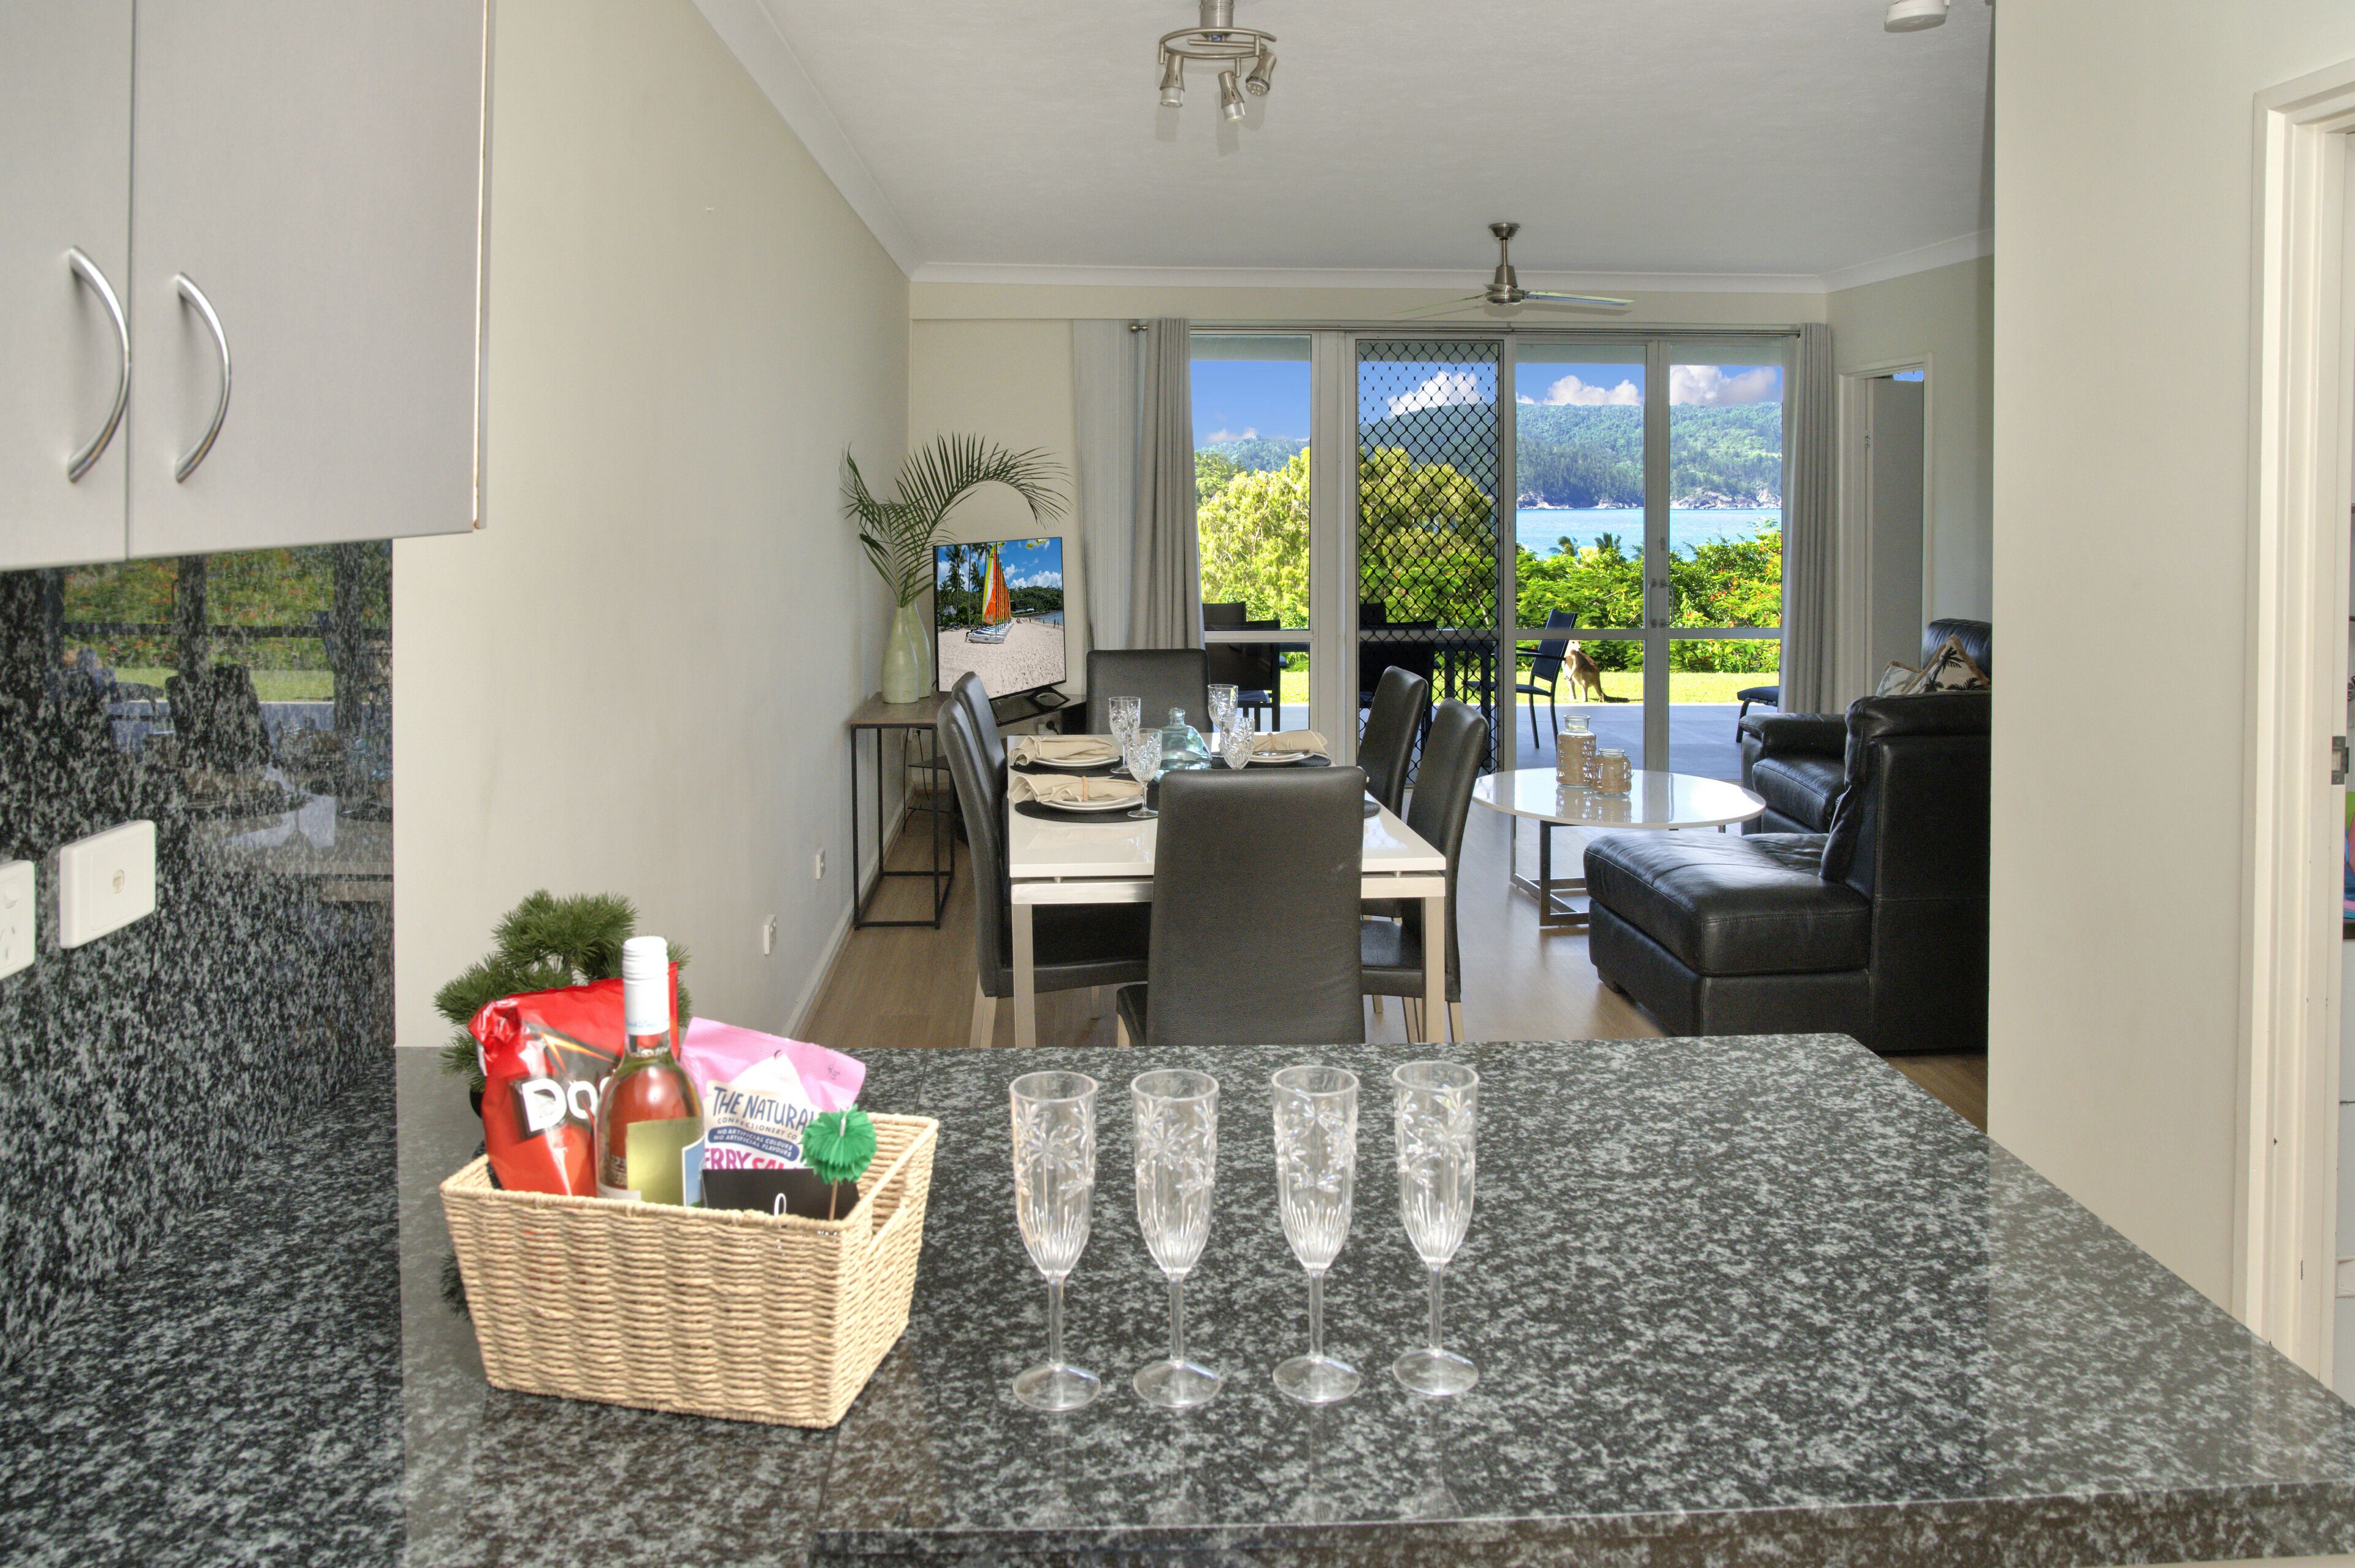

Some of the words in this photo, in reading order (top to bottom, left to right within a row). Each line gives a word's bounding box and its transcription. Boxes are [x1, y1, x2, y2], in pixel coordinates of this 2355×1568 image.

[713, 1086, 744, 1116] THE
[718, 1117, 785, 1136] CONFECTIONERY
[786, 1132, 798, 1141] CO.
[728, 1128, 764, 1142] ARTIFICIAL
[765, 1138, 793, 1151] COLOURS
[725, 1134, 760, 1147] ARTIFICIAL
[762, 1144, 792, 1158] FLAVOURS
